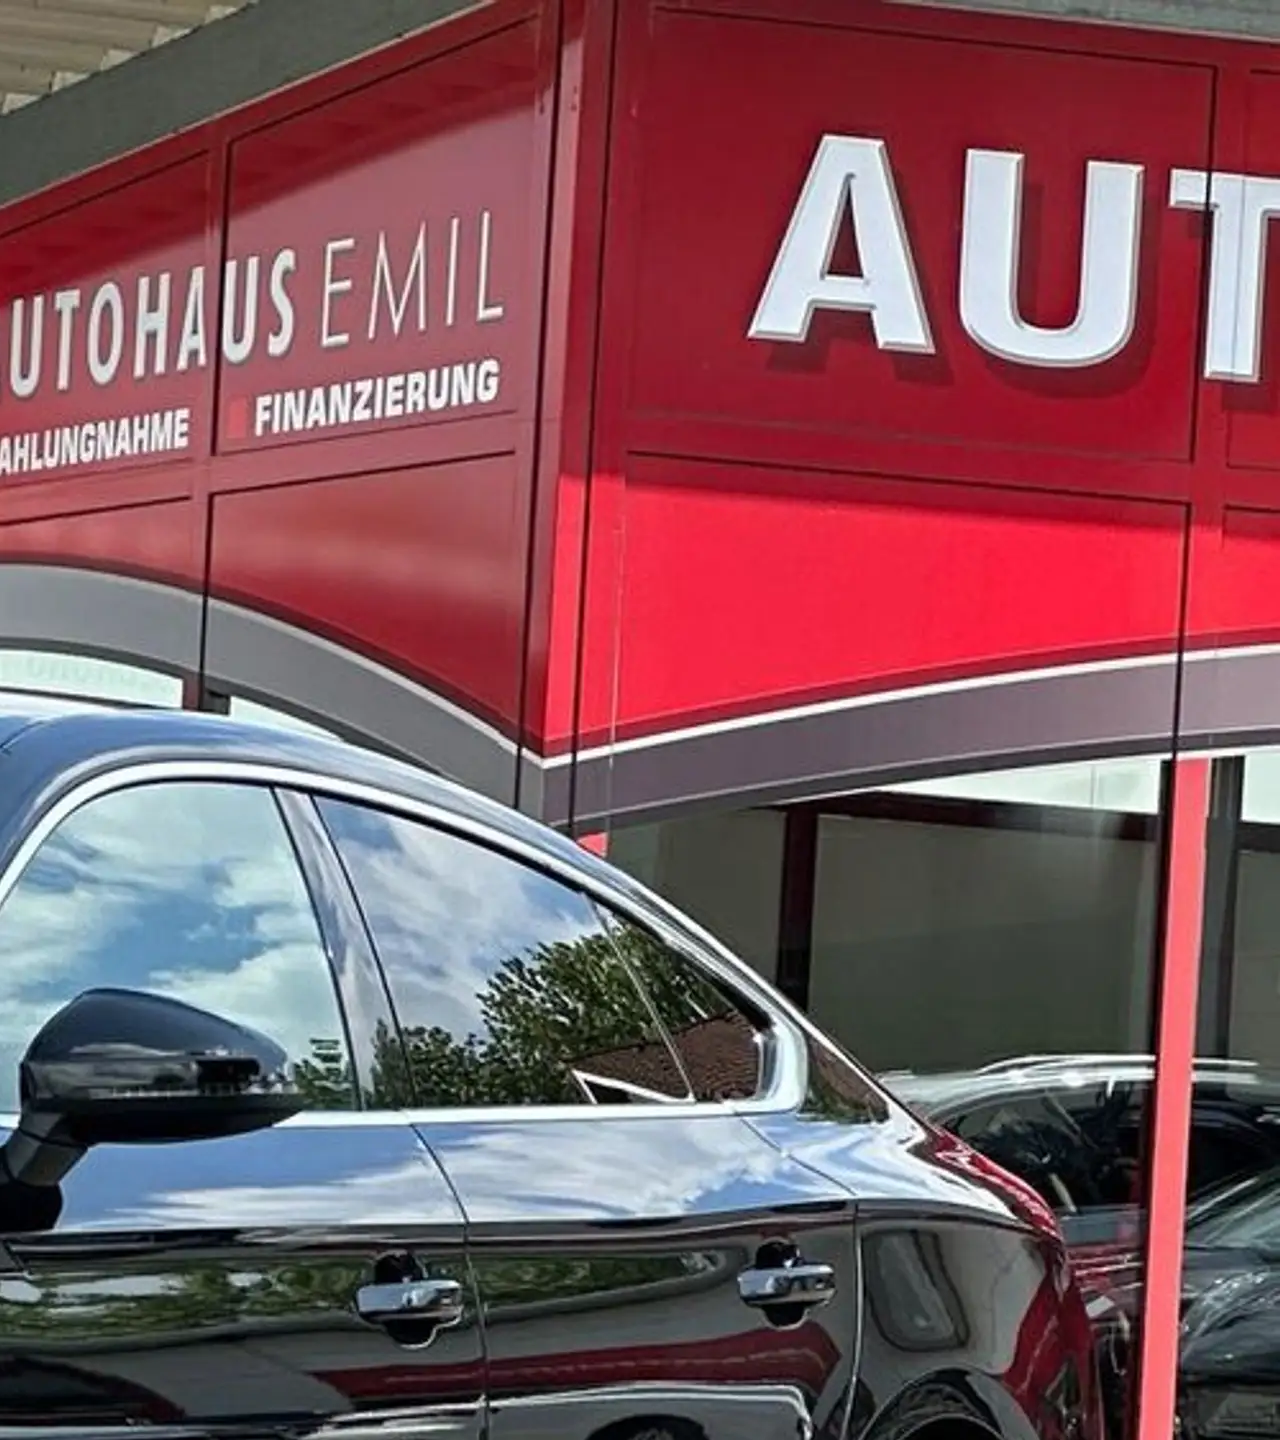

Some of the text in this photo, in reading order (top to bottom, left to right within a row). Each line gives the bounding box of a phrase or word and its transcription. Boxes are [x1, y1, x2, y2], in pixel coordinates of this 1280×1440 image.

[321, 211, 504, 347] EMIL
[747, 134, 1280, 382] AUT
[254, 358, 501, 436] FINANZIERUNG
